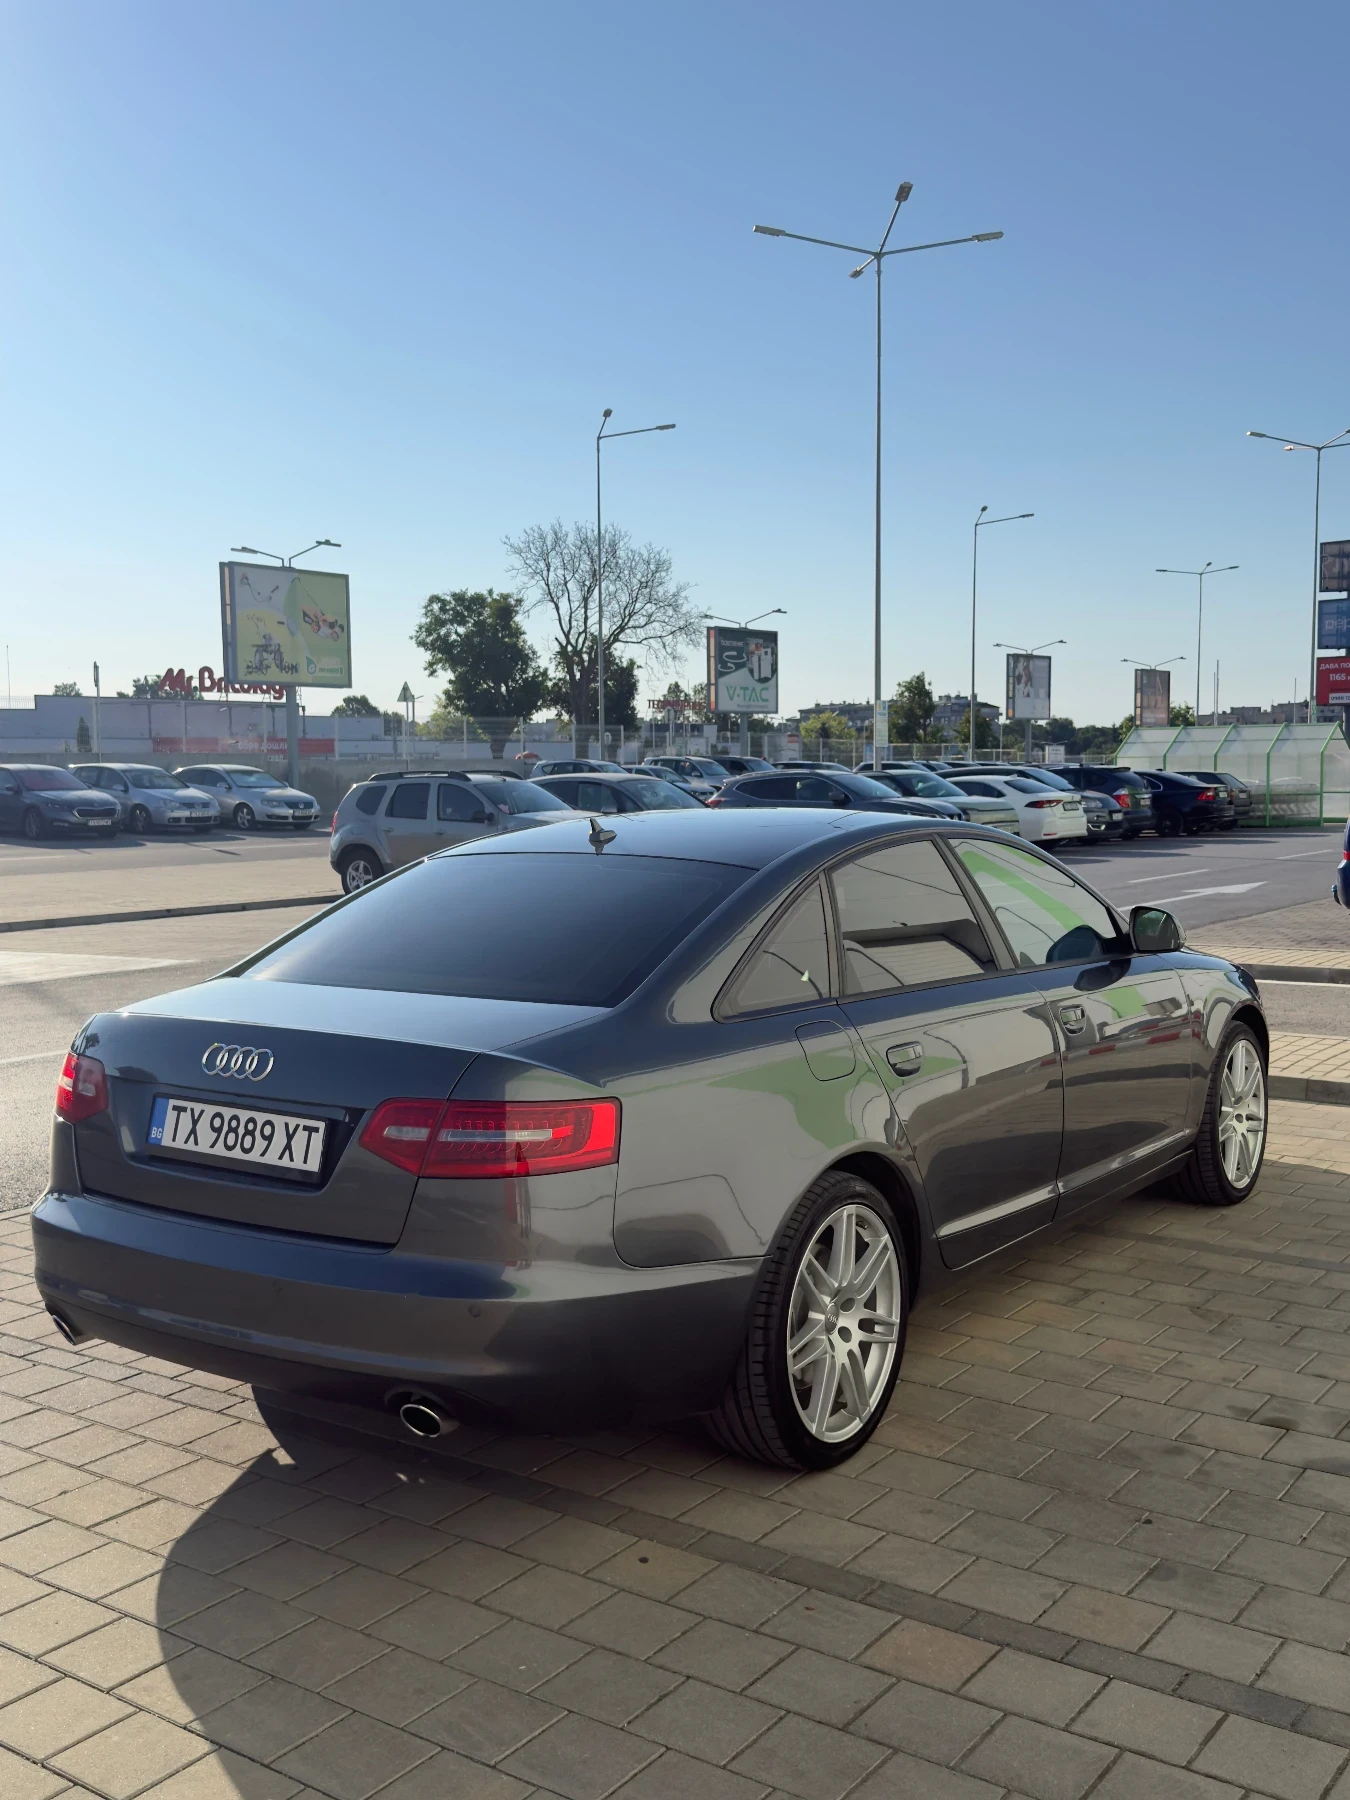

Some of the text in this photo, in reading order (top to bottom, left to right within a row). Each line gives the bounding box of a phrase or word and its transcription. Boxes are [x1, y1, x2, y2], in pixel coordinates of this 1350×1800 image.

[151, 1126, 163, 1139] BG
[171, 1104, 320, 1165] TX 9889 XT
